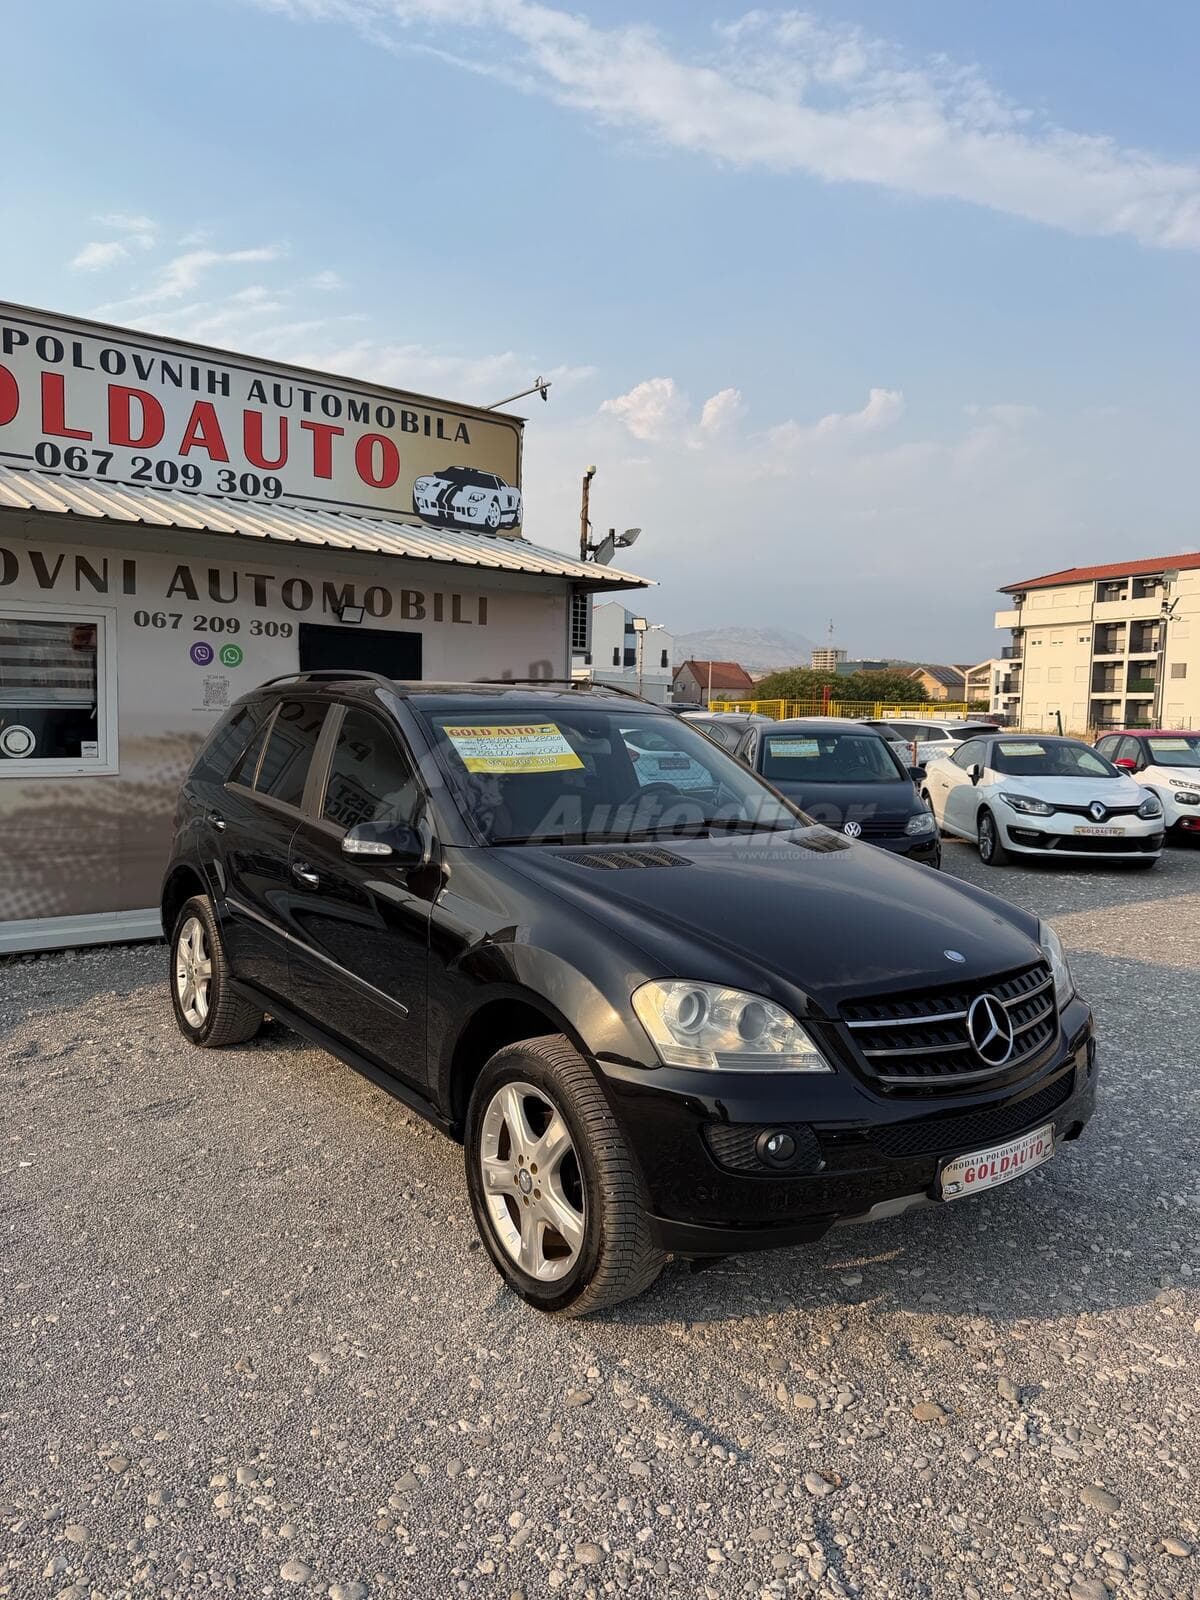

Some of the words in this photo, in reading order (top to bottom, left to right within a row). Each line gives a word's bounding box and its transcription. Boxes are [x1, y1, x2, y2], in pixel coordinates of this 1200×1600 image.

[3, 327, 231, 396] POLOVNIH
[247, 379, 471, 444] AUTOMOBILA
[34, 442, 114, 475] 067
[131, 456, 202, 488] 209
[217, 469, 283, 499] 309
[166, 564, 488, 626] AUTOMOBILI
[133, 610, 183, 630] 067
[193, 614, 241, 634] 209
[250, 618, 293, 638] 309
[449, 728, 492, 737] GOLD
[497, 727, 535, 736] AUTO
[947, 1157, 985, 1172] PRODAJA
[986, 1144, 1021, 1160] POLOVNIH
[964, 1139, 1043, 1183] GOLDAUTO
